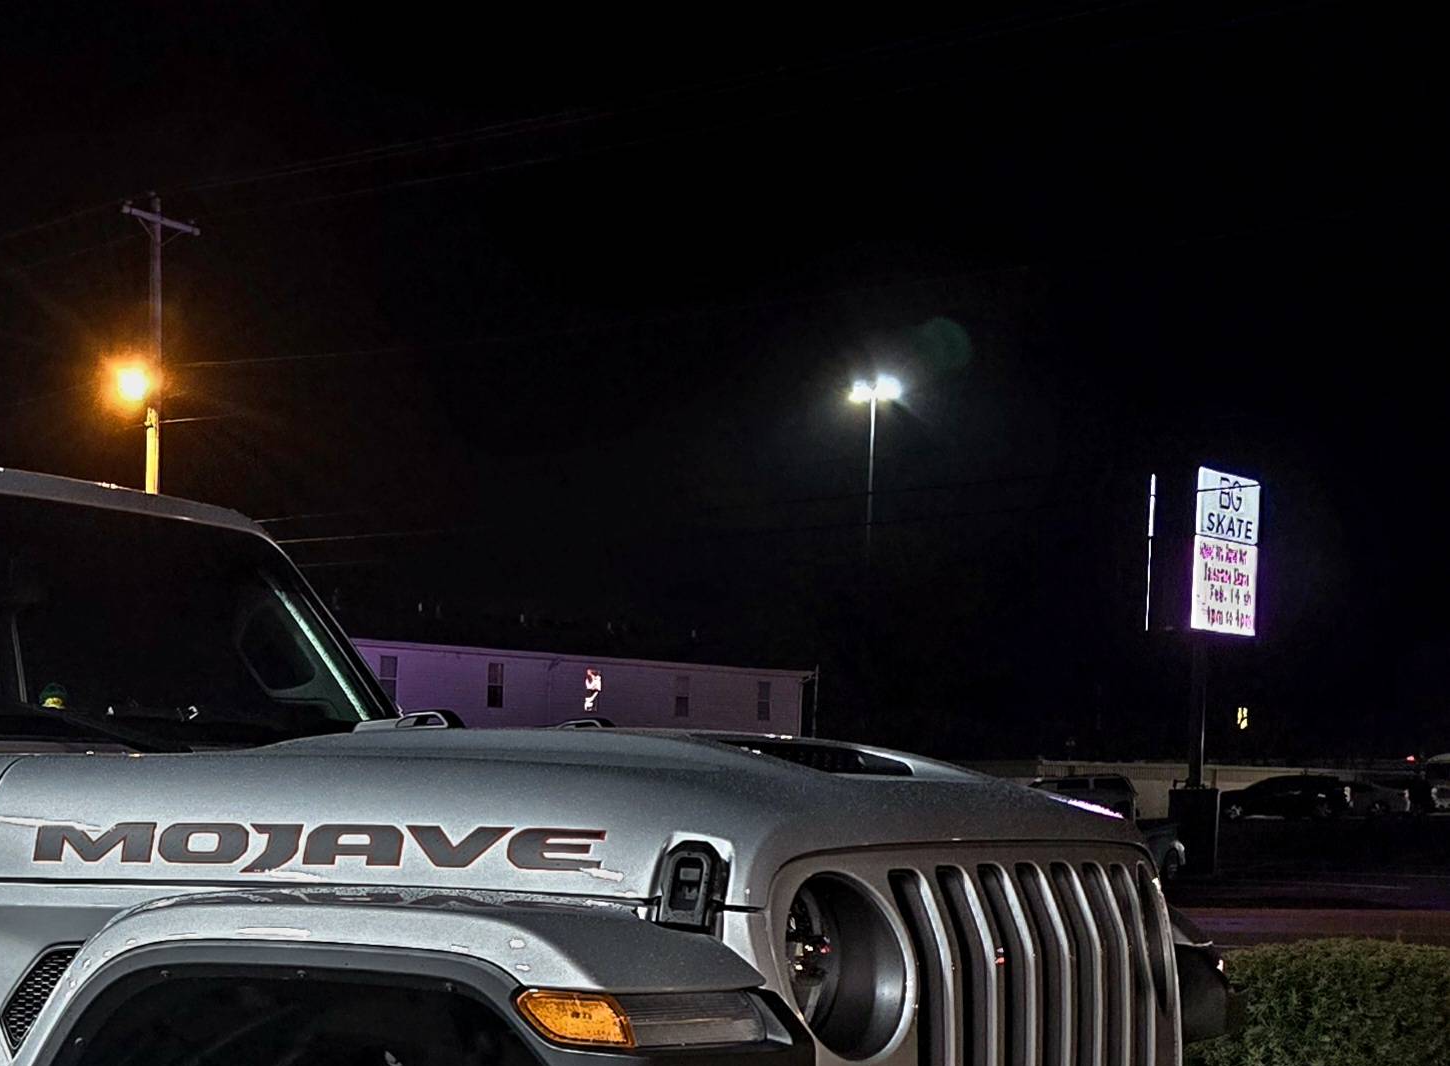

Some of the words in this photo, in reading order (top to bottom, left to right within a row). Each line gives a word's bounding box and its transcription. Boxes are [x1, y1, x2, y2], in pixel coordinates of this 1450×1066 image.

[1218, 476, 1243, 512] BG
[1206, 512, 1253, 540] SKATE
[33, 821, 606, 873] MOJAVE
